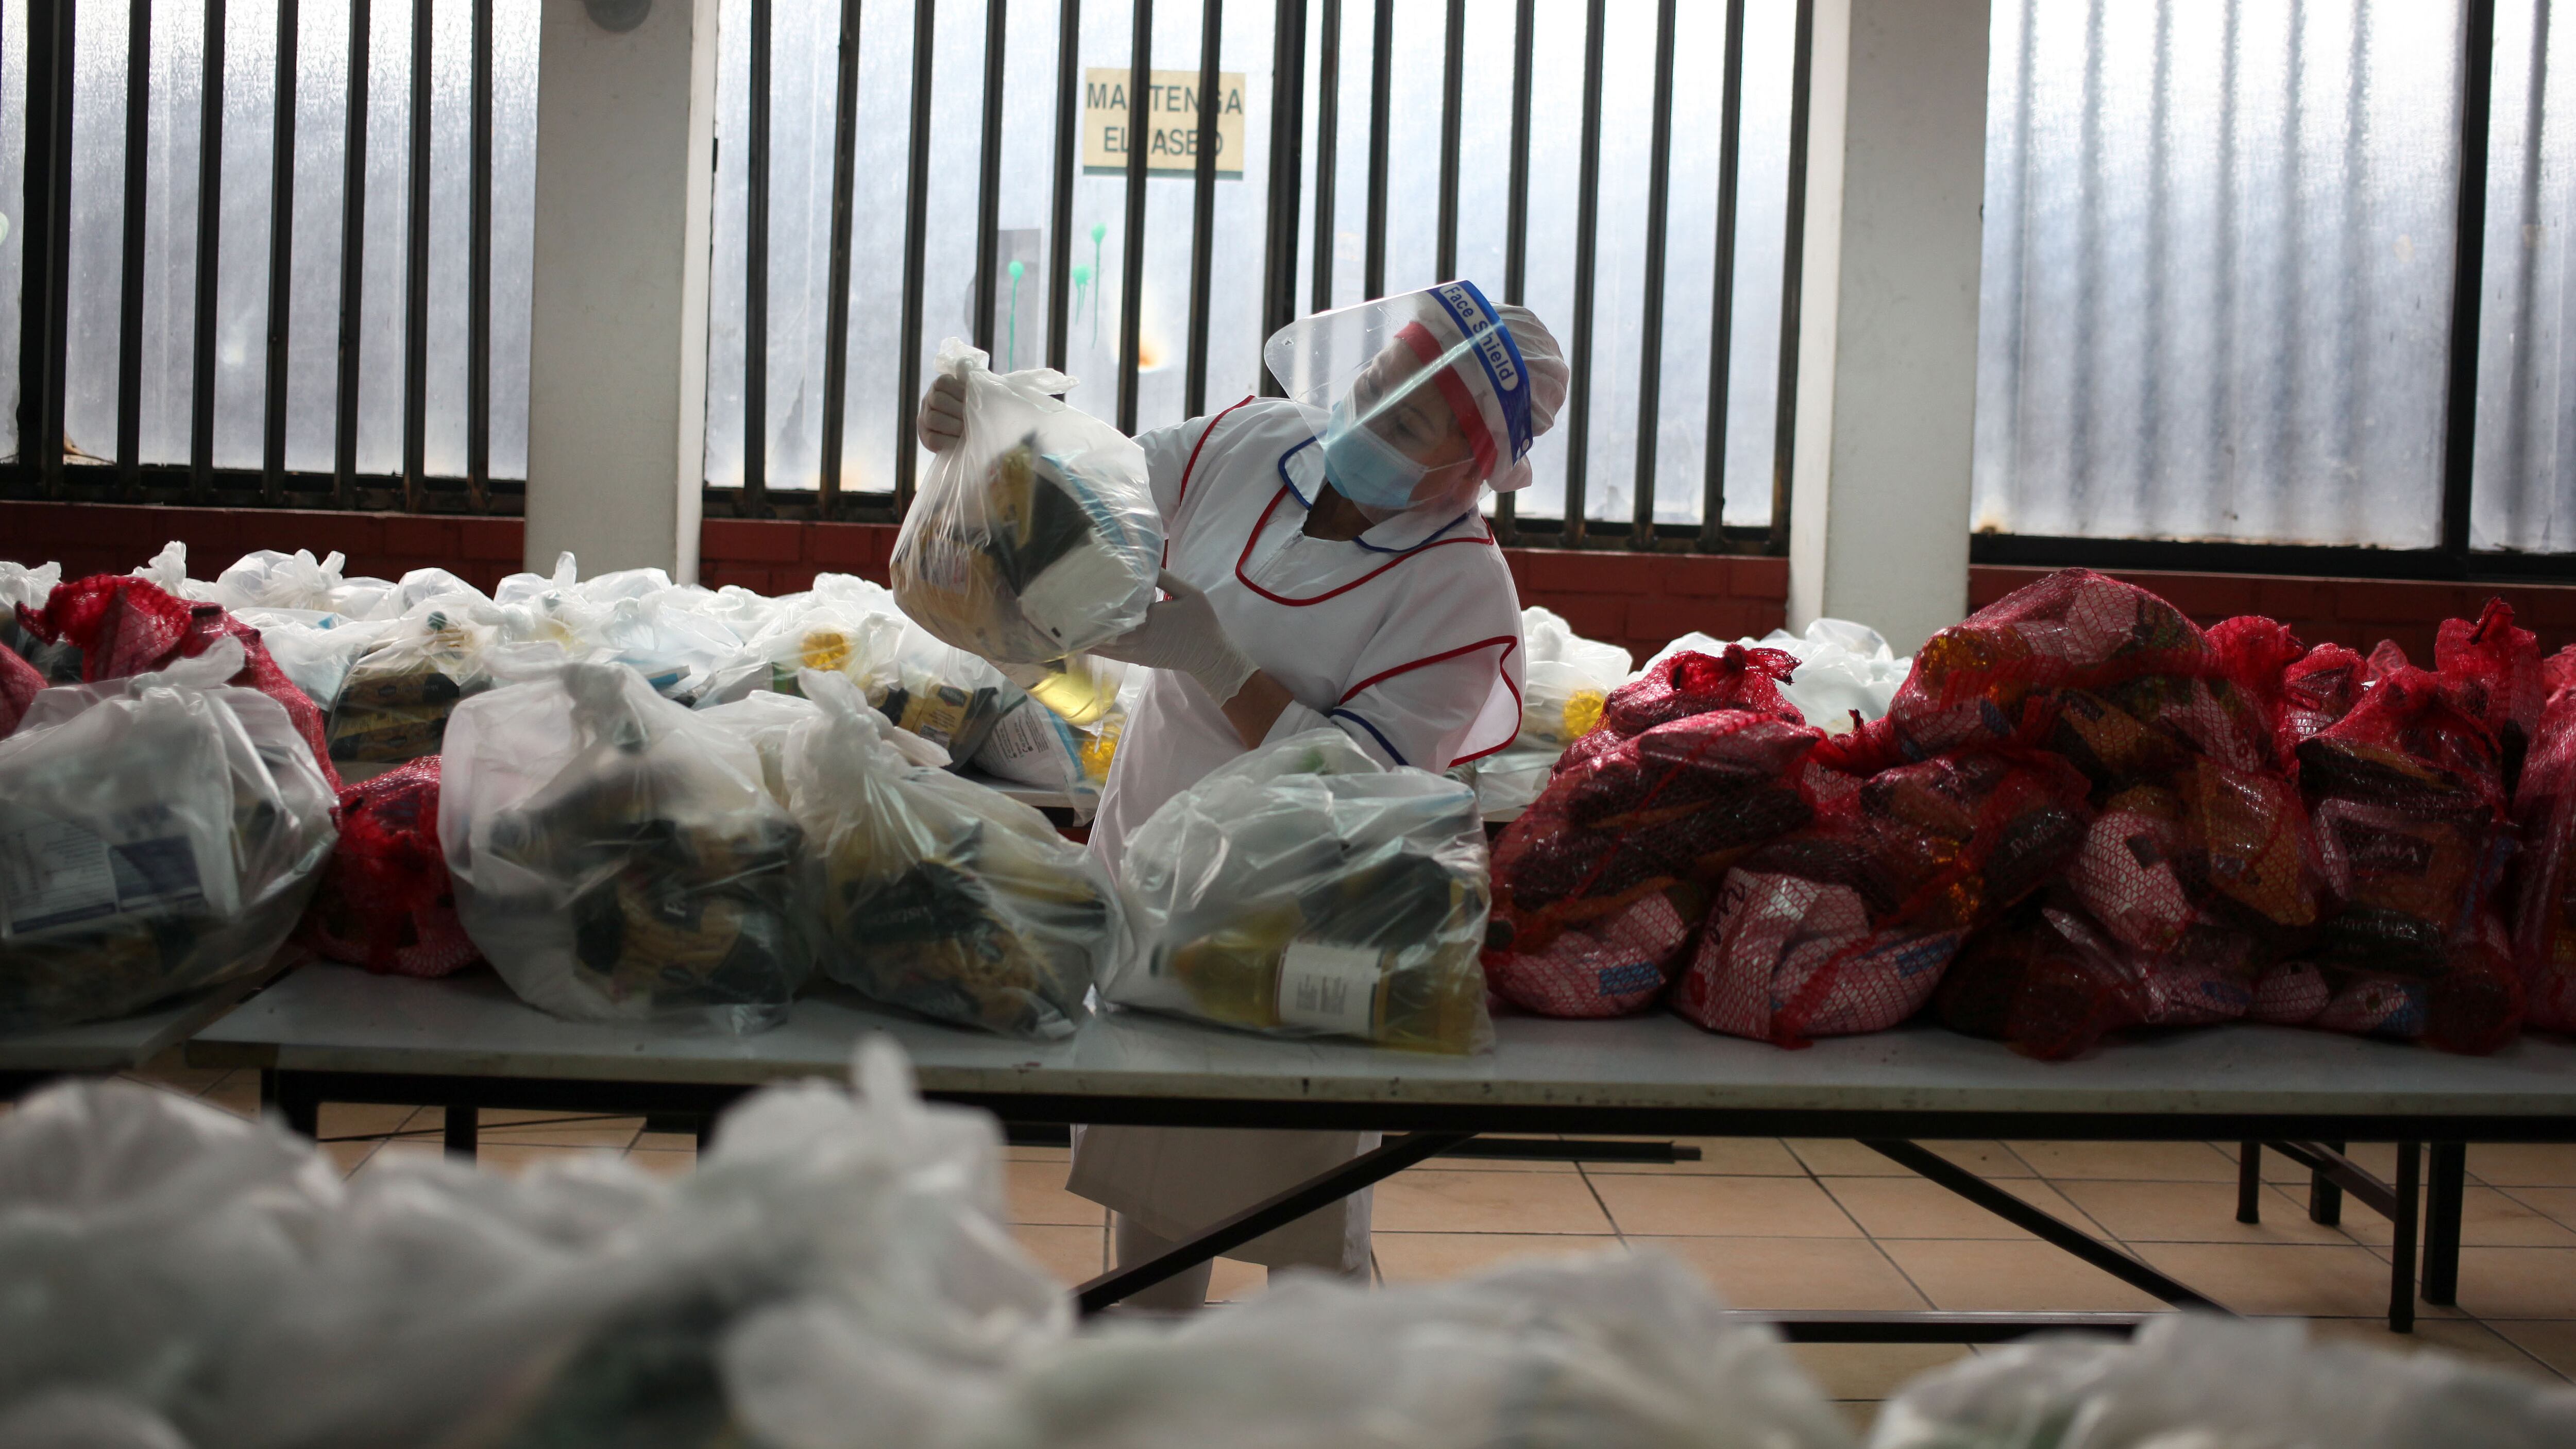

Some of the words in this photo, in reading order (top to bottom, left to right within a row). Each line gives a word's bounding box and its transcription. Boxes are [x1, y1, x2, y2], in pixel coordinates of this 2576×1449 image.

[1087, 82, 1243, 114] MATENA
[1444, 286, 1473, 318] Face
[1473, 320, 1514, 381] Shield
